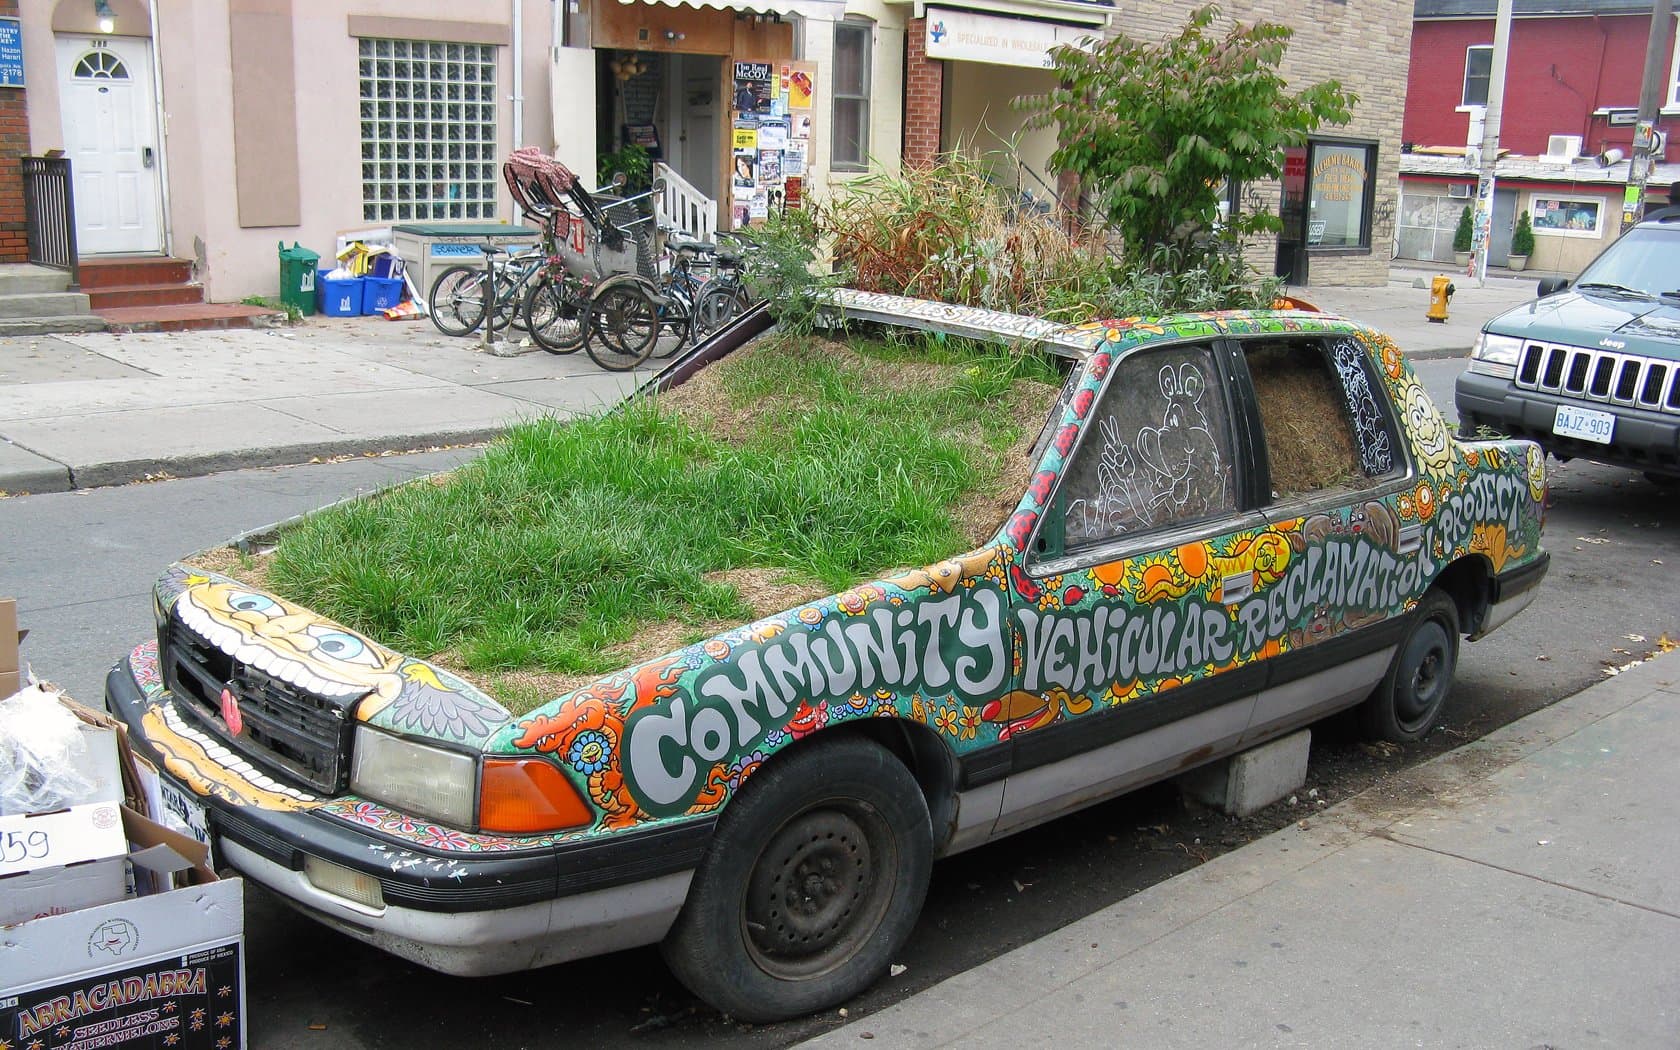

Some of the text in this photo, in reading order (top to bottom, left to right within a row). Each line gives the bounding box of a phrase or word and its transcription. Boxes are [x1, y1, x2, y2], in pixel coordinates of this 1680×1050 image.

[735, 63, 768, 72] The Real
[736, 70, 768, 80] McCOY
[911, 302, 962, 322] LESS
[1599, 338, 1626, 350] Jeep
[1590, 419, 1611, 436] 903
[1439, 472, 1527, 554] PROJECT
[18, 967, 207, 1041] ABRACADABRA
[72, 1008, 160, 1041] SEEDLESS
